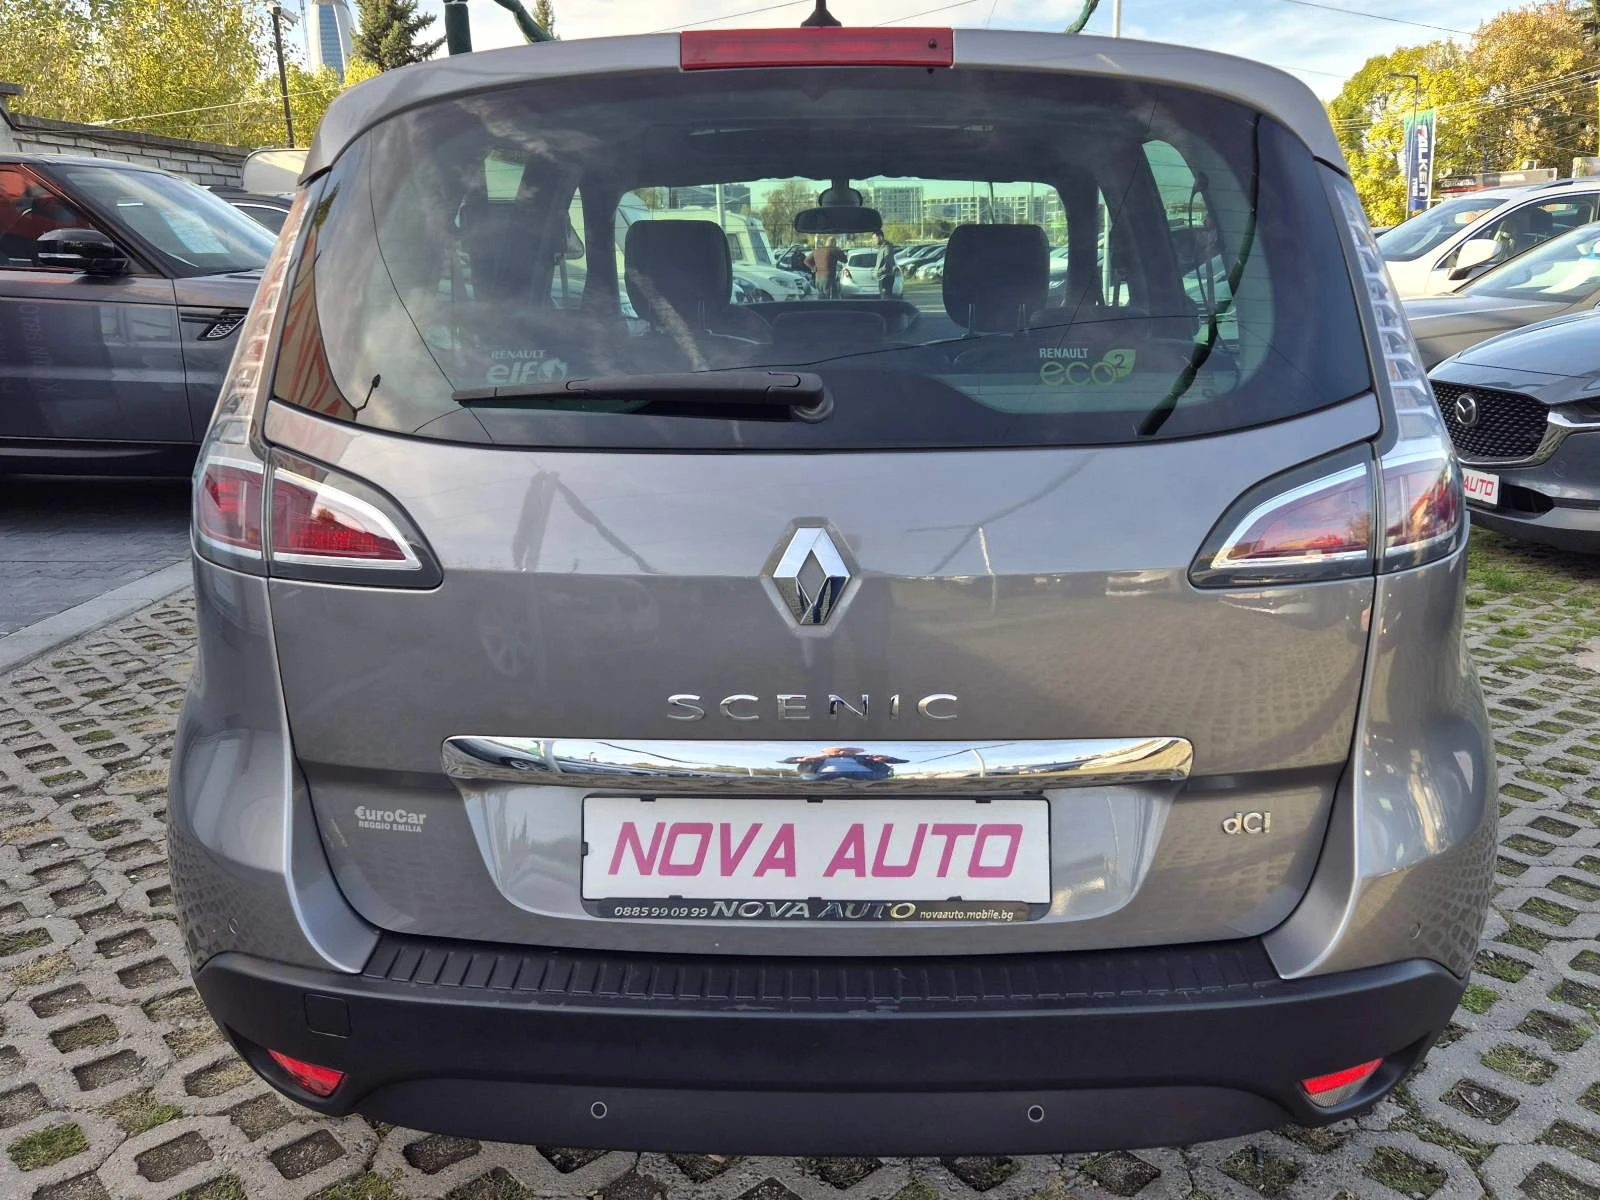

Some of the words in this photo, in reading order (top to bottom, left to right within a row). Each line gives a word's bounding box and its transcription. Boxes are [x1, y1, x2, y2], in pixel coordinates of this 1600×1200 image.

[491, 350, 546, 359] RENAULT
[1039, 348, 1088, 359] RENAULT
[486, 361, 538, 384] elf
[1464, 475, 1495, 497] AUTO
[667, 694, 959, 720] SCENIC
[358, 820, 391, 831] REGGIO
[392, 823, 422, 833] EMILIA
[608, 822, 797, 877] NOVA
[822, 823, 1024, 878] AUTO
[614, 906, 649, 917] 0885
[651, 907, 668, 917] 99
[670, 907, 688, 917] 09
[690, 907, 708, 918] 99
[710, 901, 811, 918] NOVA
[817, 902, 917, 919] AUTO
[919, 909, 1014, 922] novaauto.mobile.bg
